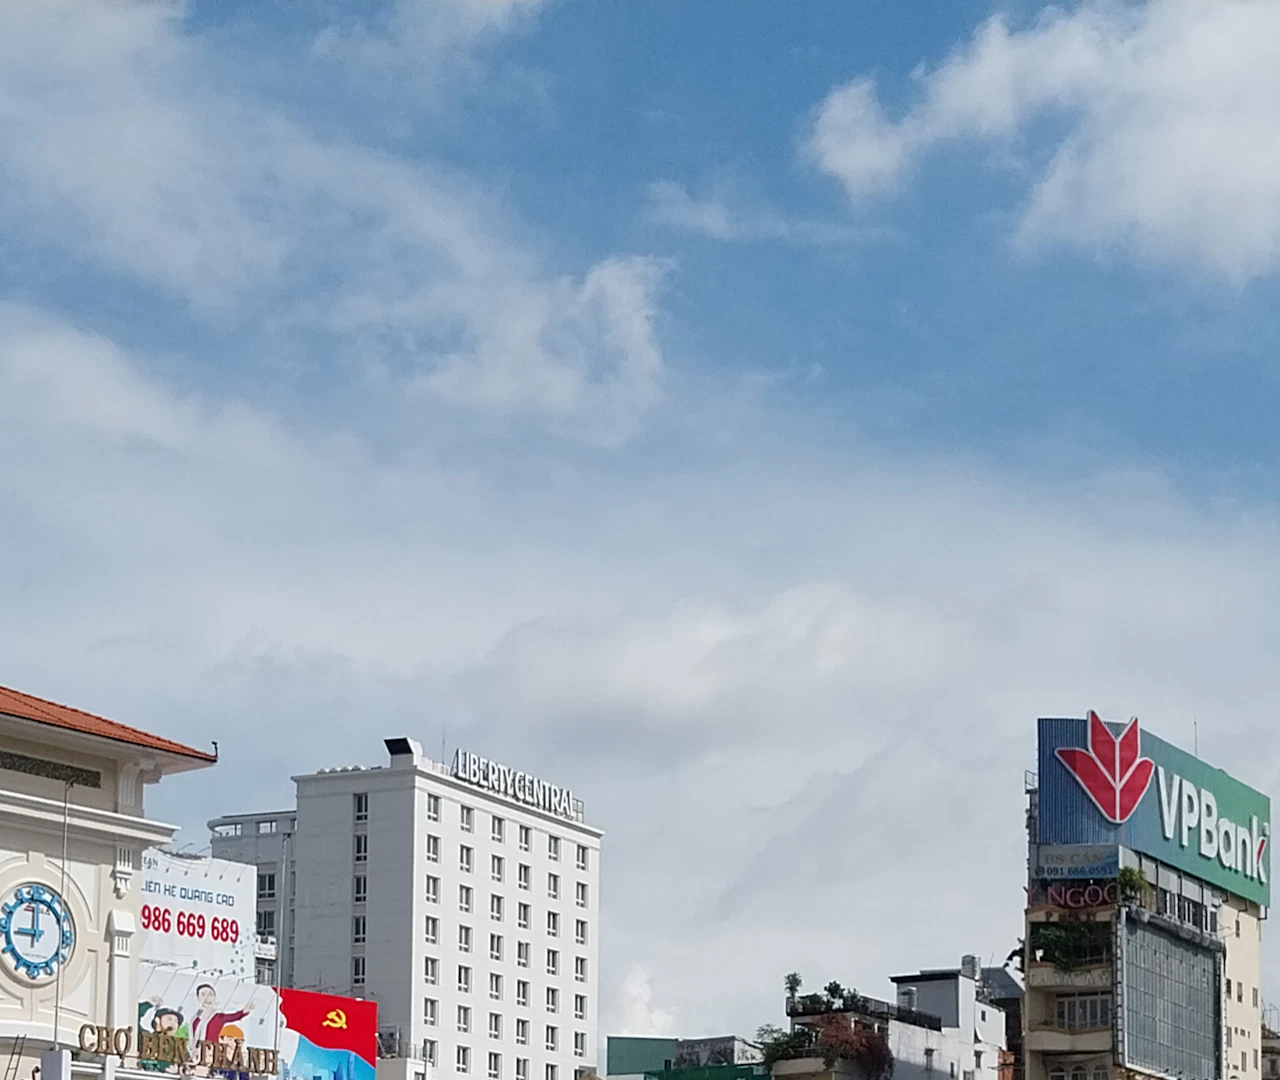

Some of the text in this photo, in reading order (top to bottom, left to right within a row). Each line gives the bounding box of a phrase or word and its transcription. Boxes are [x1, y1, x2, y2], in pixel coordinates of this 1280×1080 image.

[457, 748, 576, 817] LIBERTY CENTRAL
[1157, 765, 1268, 884] VPBank
[141, 904, 239, 944] 986 669 689
[79, 1025, 280, 1075] CHỢ BẾN THÀNH
